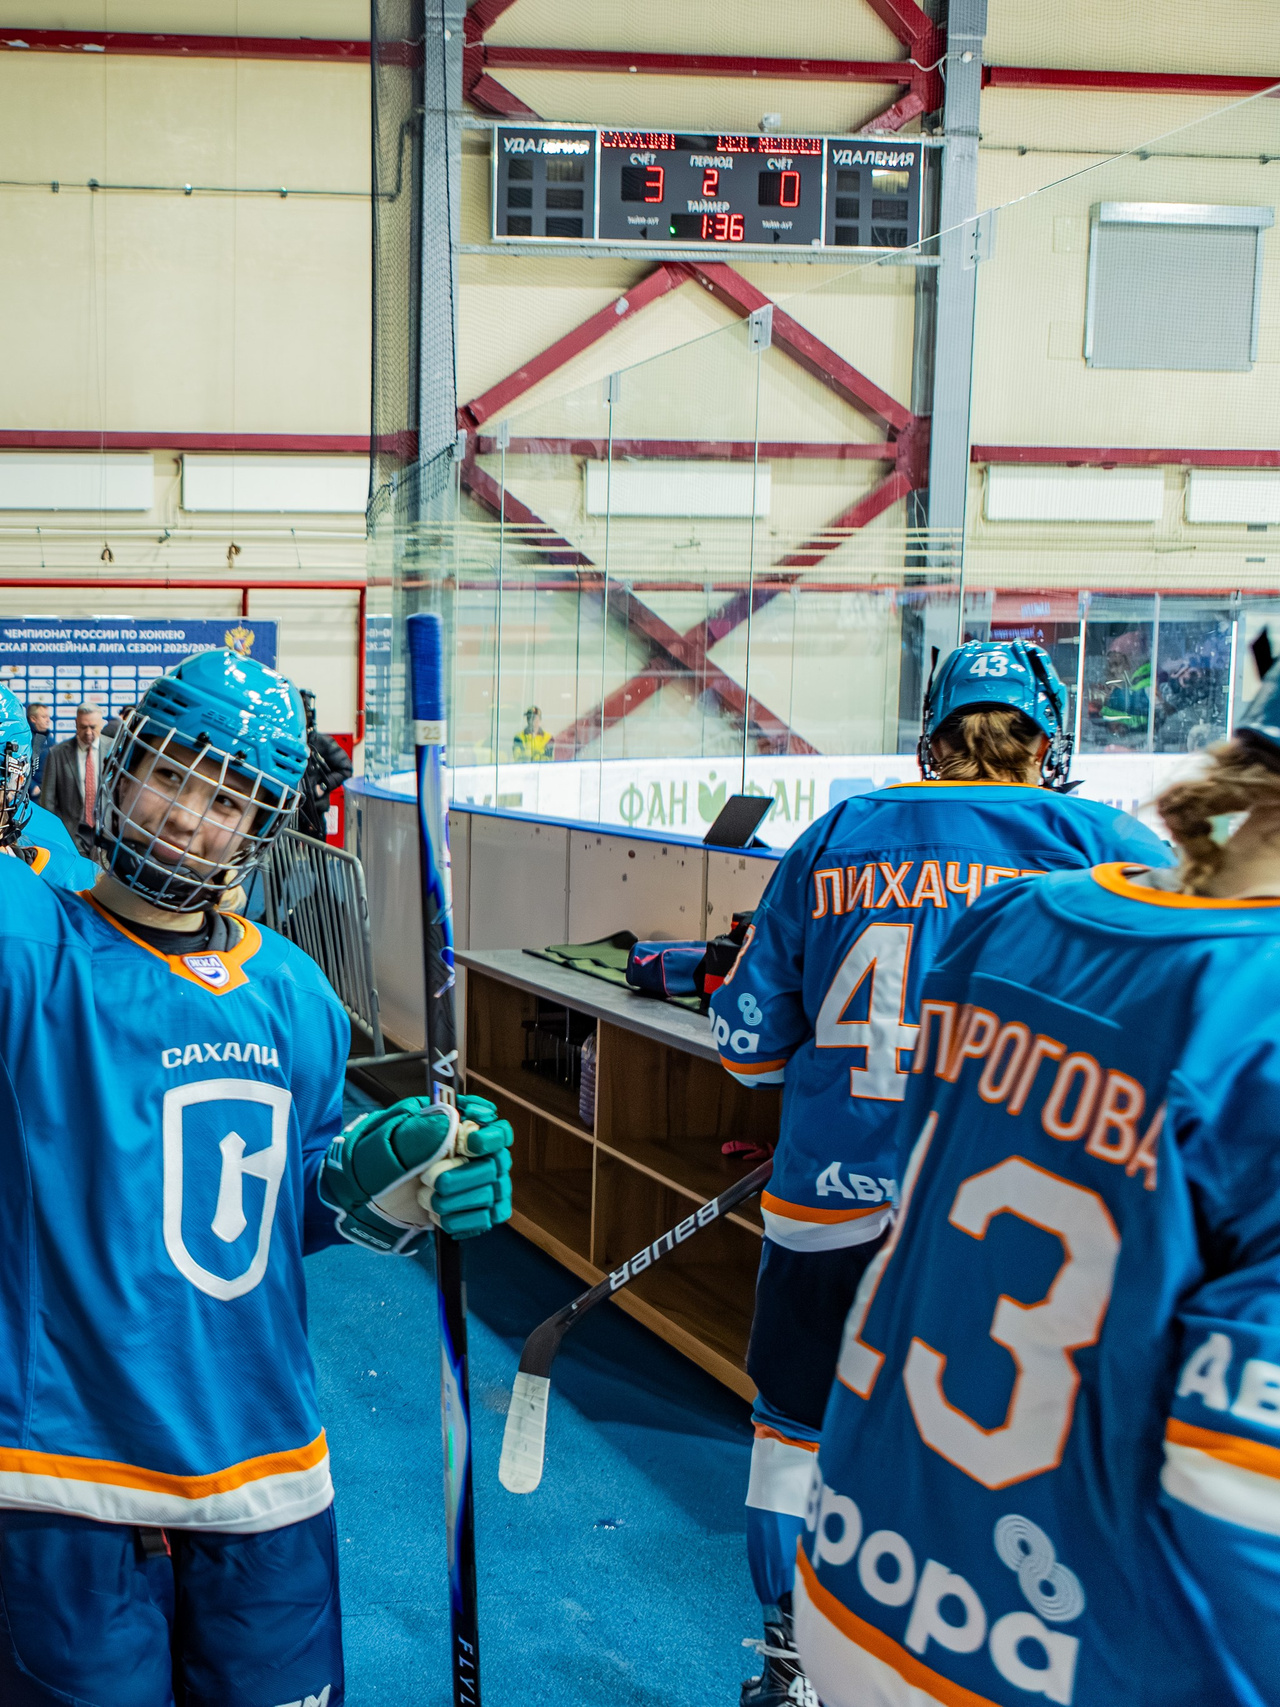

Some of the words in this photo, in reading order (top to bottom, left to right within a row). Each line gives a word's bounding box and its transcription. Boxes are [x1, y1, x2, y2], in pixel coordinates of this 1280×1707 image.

[503, 137, 590, 155] УДАЛЕНИЯ
[630, 152, 657, 166] СЧЁТ
[689, 154, 734, 169] ПЕРИОД
[766, 156, 793, 170] СЧЁТ
[832, 149, 915, 167] УДАЛЕНИЯ
[645, 166, 665, 203] 3
[702, 169, 719, 196] 2
[779, 171, 800, 207] 0
[687, 199, 731, 213] ТАЙМЕР
[701, 213, 745, 241] 1:36
[4, 629, 72, 639] ЧЕМПИОНАТ
[73, 630, 119, 640] РОССИИ
[120, 630, 137, 640] ПО
[139, 630, 186, 640] ХОККЕЮ
[30, 641, 96, 652] ХОККЕЙНАЯ
[98, 643, 126, 652] ЛИГА
[126, 643, 162, 653] СЕЗОН
[163, 643, 217, 653] 2025/2026
[969, 656, 1009, 678] 43
[619, 780, 688, 827] ФАН
[812, 861, 1050, 919] ЛИХАЧ
[608, 1197, 720, 1291] BAUER
